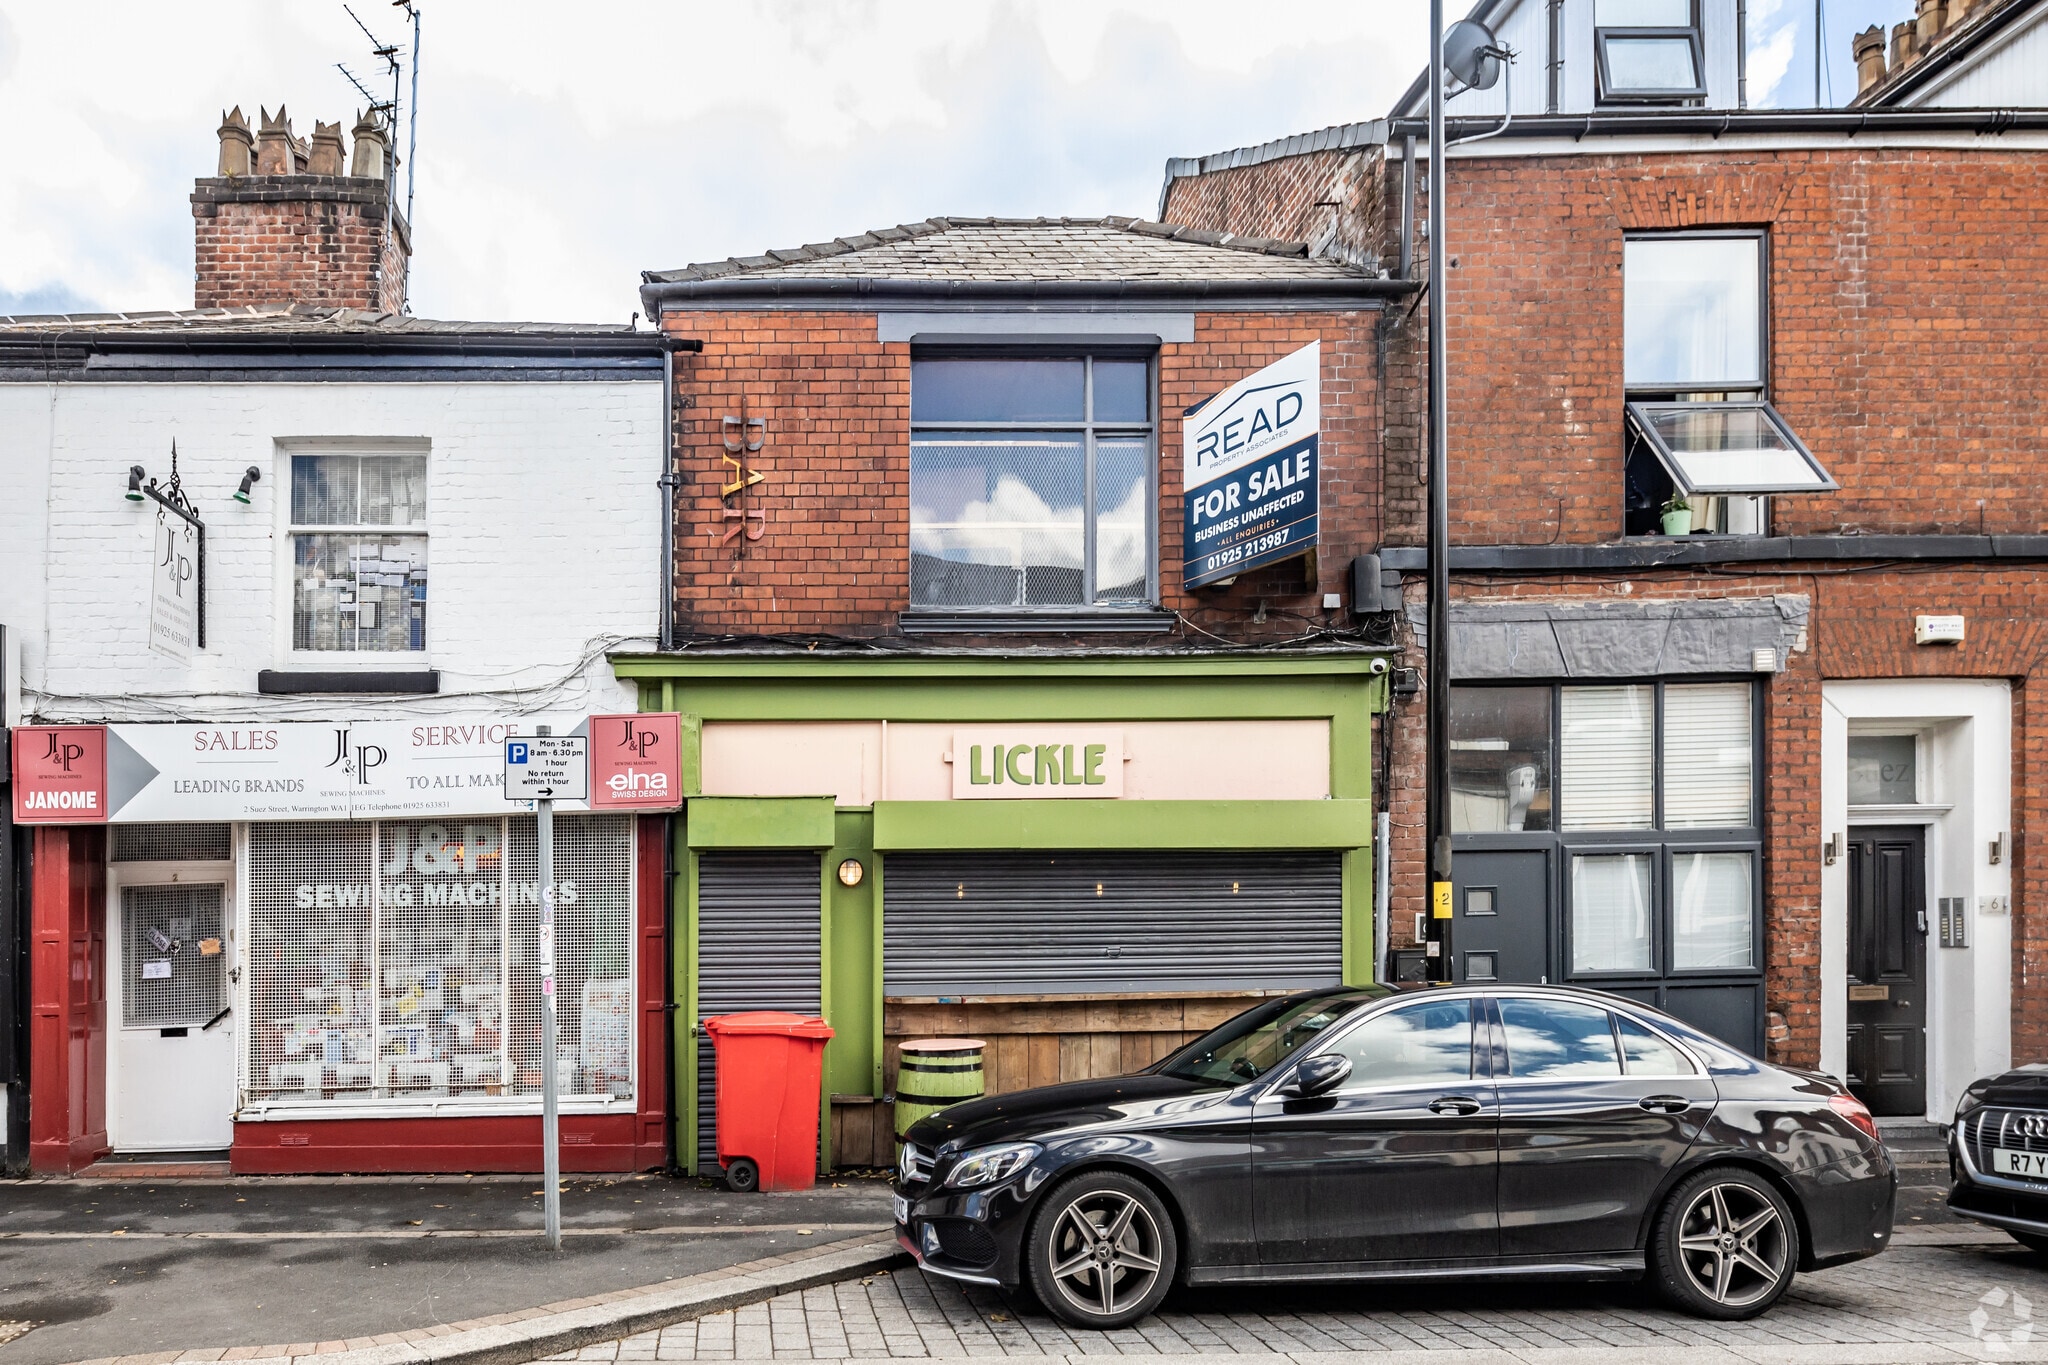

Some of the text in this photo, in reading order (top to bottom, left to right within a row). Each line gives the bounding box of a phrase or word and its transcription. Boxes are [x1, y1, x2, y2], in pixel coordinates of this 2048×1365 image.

[1197, 391, 1303, 466] READ
[1209, 429, 1289, 469] PROPERTY ASSOCIATES
[722, 412, 765, 548] BAR
[1192, 449, 1310, 525] FOR SALE
[1194, 489, 1305, 543] BUSINESS UNAFFECTED
[1207, 528, 1290, 571] 01925 213987
[153, 621, 190, 648] 01925 633831
[194, 730, 279, 751] SALES
[512, 745, 525, 762] P
[970, 744, 1106, 785] LICKLE
[174, 778, 305, 793] LEADING BRANDS
[406, 773, 506, 789] TO ALL MAK
[605, 768, 667, 790] elna
[25, 791, 97, 809] JANOME
[348, 789, 386, 797] MACHINES
[611, 789, 668, 798] SWISS DESIGN
[268, 805, 290, 813] Street,
[291, 805, 329, 813] Warrington
[368, 803, 401, 812] Telephone
[403, 802, 424, 810] 01925
[425, 801, 450, 809] 633831
[383, 824, 501, 875] J&P
[295, 882, 413, 907] SEWING
[1991, 898, 1999, 909] 6
[2010, 1153, 2048, 1175] R7 Y
